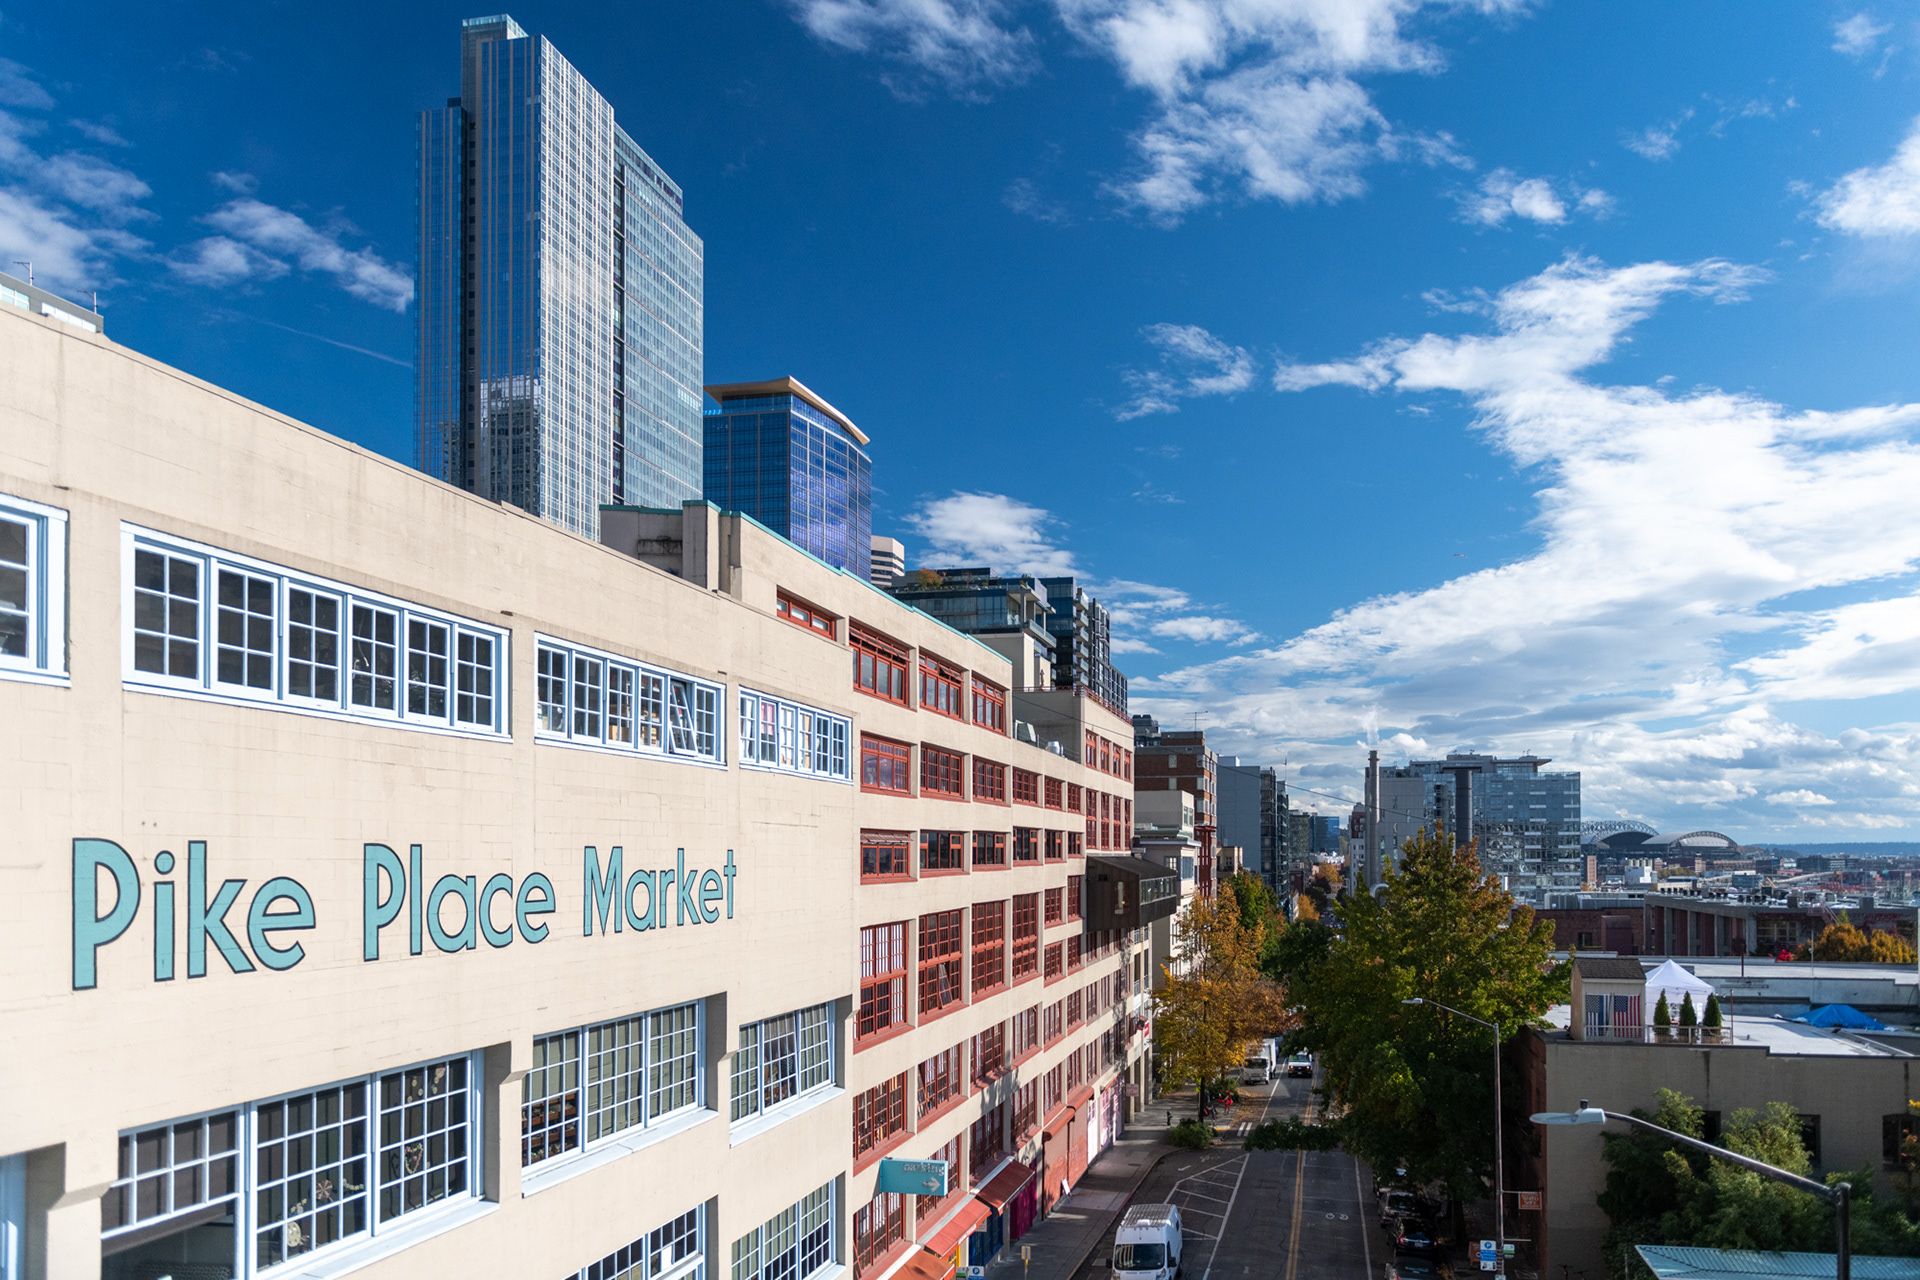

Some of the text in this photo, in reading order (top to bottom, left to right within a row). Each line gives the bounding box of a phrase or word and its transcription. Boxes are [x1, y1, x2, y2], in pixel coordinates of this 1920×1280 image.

[72, 837, 737, 990] Pike Place Market
[903, 1162, 944, 1176] parking
